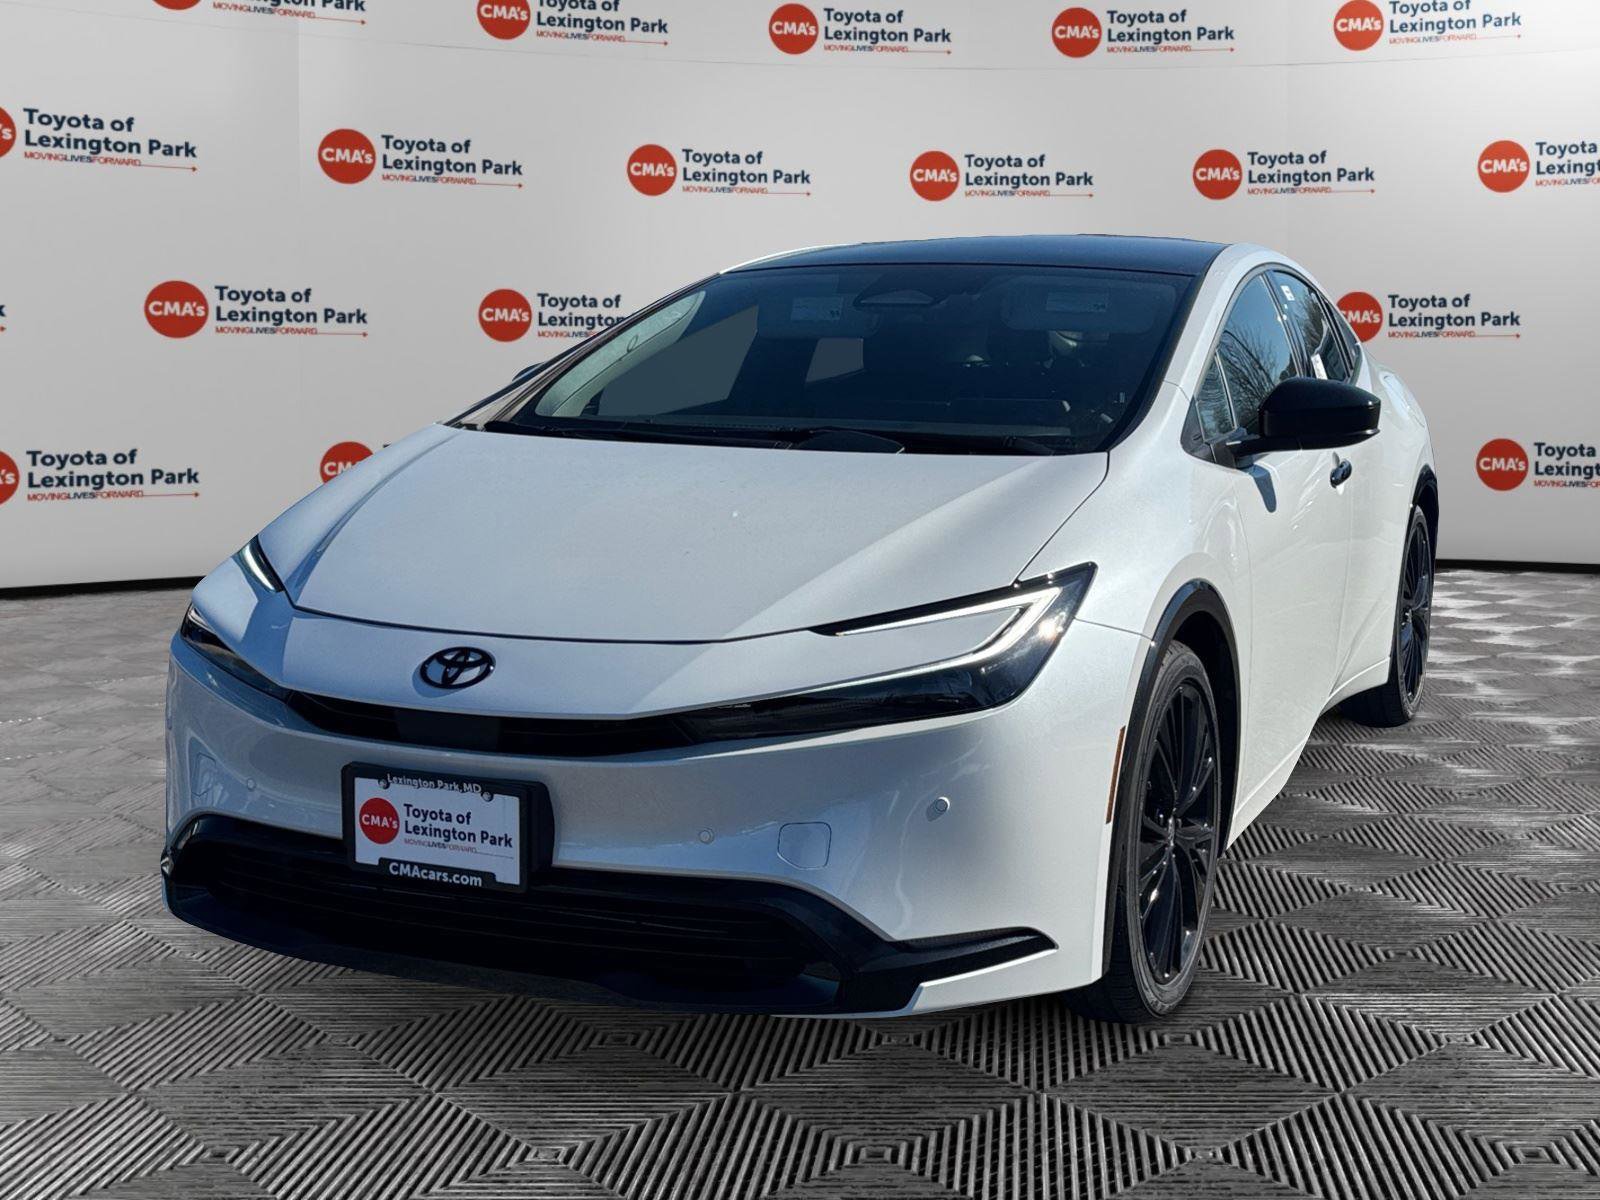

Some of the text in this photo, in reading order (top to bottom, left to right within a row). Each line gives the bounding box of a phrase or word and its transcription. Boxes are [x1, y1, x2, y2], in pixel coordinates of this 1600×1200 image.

[480, 5, 528, 20] CMA's
[601, 0, 620, 11] of
[1389, 0, 1471, 17] Toyota of
[537, 12, 668, 33] Lexington Park
[824, 8, 904, 25] Toyota of
[1106, 9, 1187, 27] Toyota of
[1336, 17, 1382, 32] CMA's
[1389, 12, 1521, 34] Lexington Park
[771, 21, 816, 36] CMA's
[824, 26, 951, 44] Lexington Park
[1054, 25, 1099, 39] CMA's
[1107, 26, 1234, 45] Lexington Park
[23, 107, 104, 131] Toyota
[110, 117, 135, 132] of
[25, 129, 141, 155] Lexington
[148, 139, 197, 158] Park
[381, 134, 471, 154] Toyota of
[1535, 141, 1598, 159] Toyota
[24, 152, 142, 166] MOVINGLIVESFORWARD
[321, 147, 373, 164] CMA's
[682, 148, 763, 166] Toyota of
[965, 154, 1045, 171] Toyota of
[1247, 150, 1327, 168] Toyota of
[382, 154, 523, 176] Lexington Park
[630, 162, 675, 177] CMA's
[1195, 167, 1240, 181] CMA's
[1480, 158, 1527, 174] CMA's
[382, 174, 476, 184] MOVINGLIVESFORWARD
[682, 167, 810, 186] Lexington Park
[912, 168, 957, 183] CMA's
[965, 172, 1093, 189] Lexington Park
[1247, 167, 1375, 186] Lexington Park
[214, 285, 312, 305] Toyota of
[537, 293, 621, 311] Toyota of
[1388, 293, 1471, 311] Toyota of
[149, 301, 206, 317] CMA's
[215, 306, 368, 327] Lexington Park
[481, 308, 529, 322] CMA's
[1341, 309, 1380, 323] MA's
[1388, 311, 1520, 329] Lexington Park
[215, 326, 318, 335] MOVINGLIVESFORWARD
[26, 448, 138, 470] Toyota of
[1533, 442, 1596, 460] Toyota
[1480, 457, 1526, 471] CMA's
[27, 471, 144, 490] Lexington
[151, 468, 199, 485] Park
[27, 490, 144, 501] MOVINGLIVESFORWARD
[387, 773, 435, 789] Lexington
[361, 813, 399, 830] CMA's
[404, 803, 472, 826] Toyota of
[404, 820, 513, 848] Lexington Park
[389, 861, 483, 888] CMAcars.com
